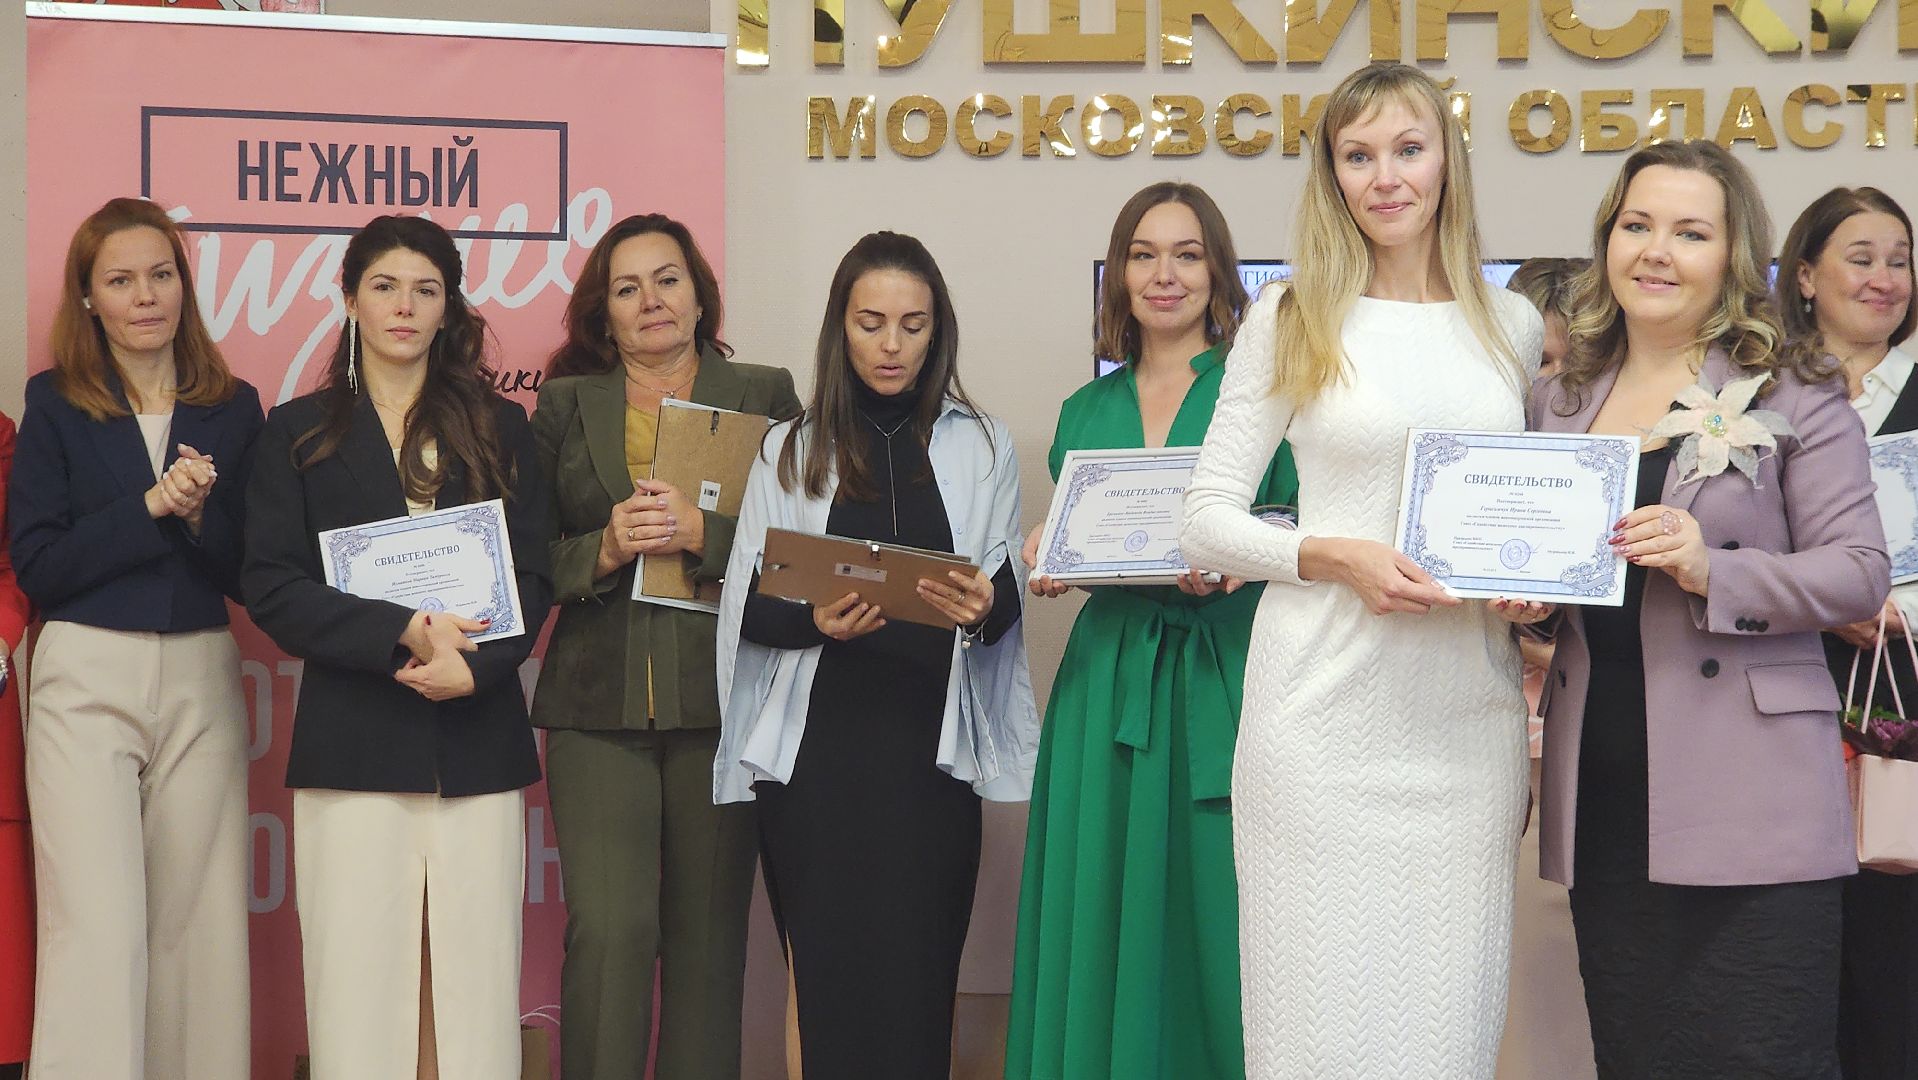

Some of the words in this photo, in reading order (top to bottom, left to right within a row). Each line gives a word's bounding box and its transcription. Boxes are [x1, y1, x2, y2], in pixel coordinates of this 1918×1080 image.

[806, 76, 1472, 160] МОСКОВСК
[1508, 83, 1918, 154] ОБЛАСТ
[238, 136, 480, 208] НЕЖНЫЙ
[1104, 486, 1186, 498] СВИДЕТЕЛЬСТВО
[1464, 473, 1573, 489] СВИДЕТЕЛЬСТВО
[374, 544, 460, 567] СВИДЕТЕЛЬСТВО
